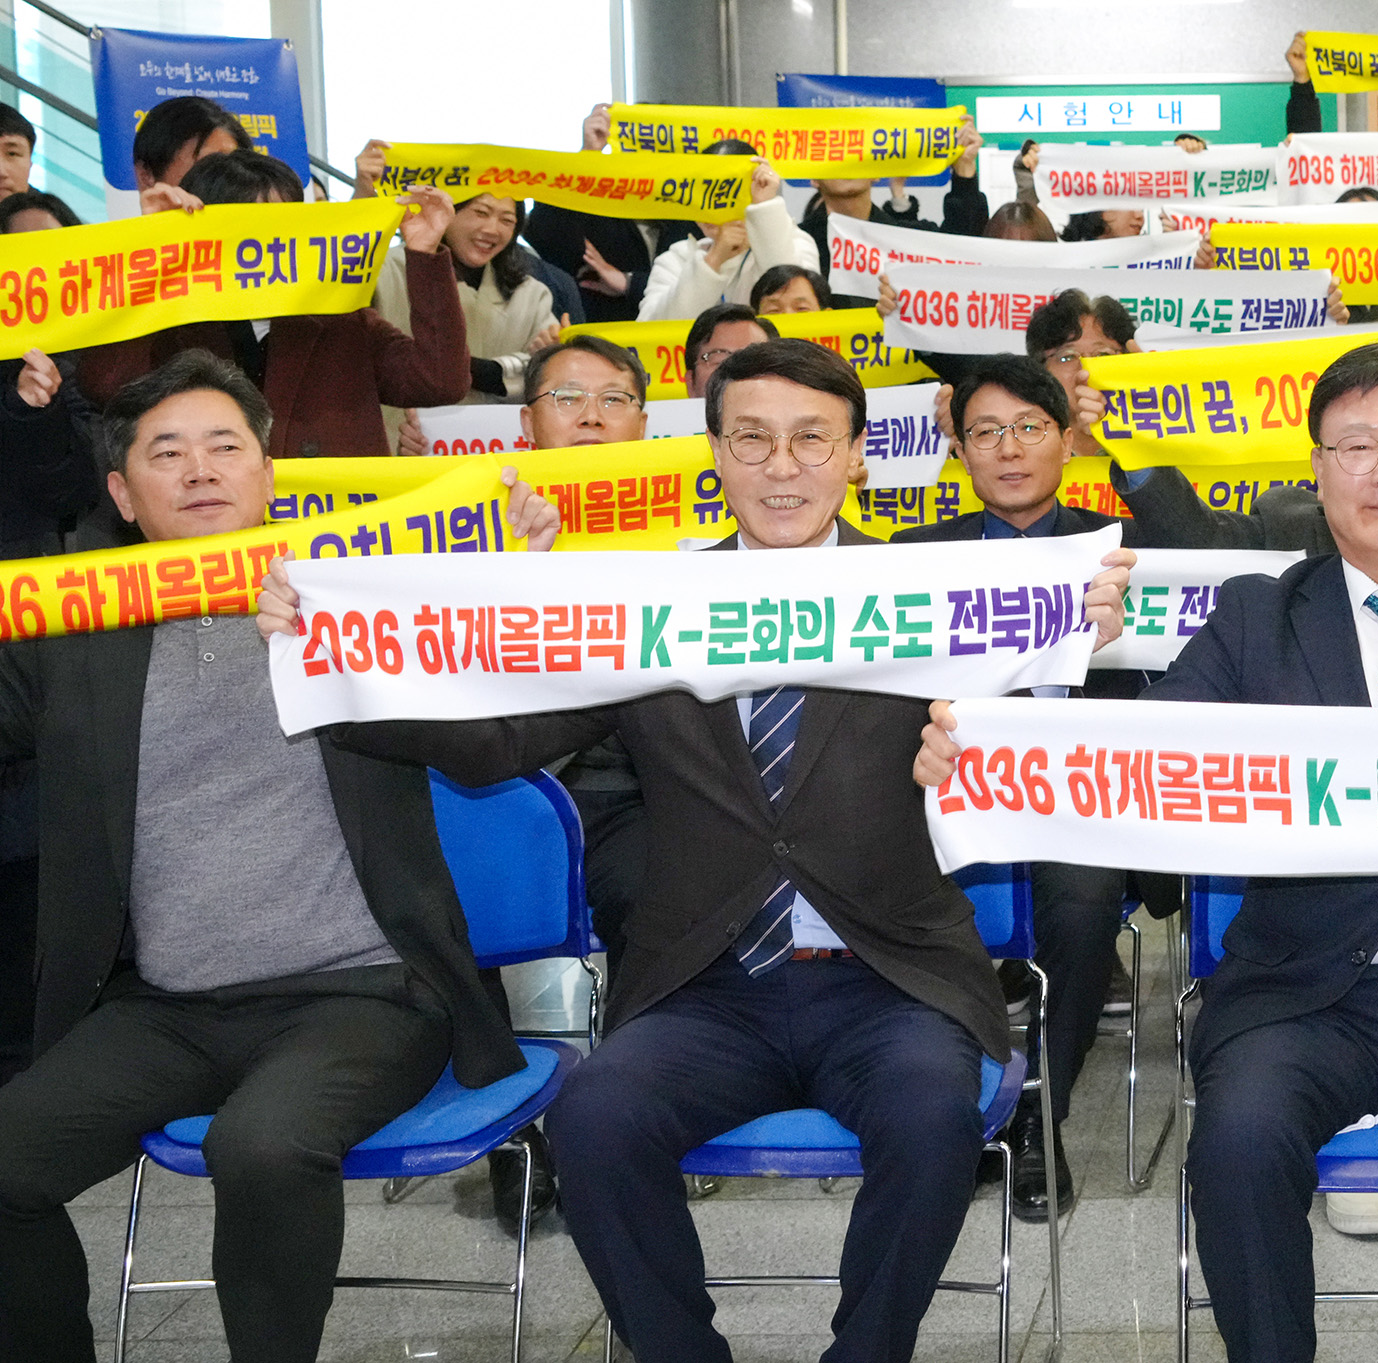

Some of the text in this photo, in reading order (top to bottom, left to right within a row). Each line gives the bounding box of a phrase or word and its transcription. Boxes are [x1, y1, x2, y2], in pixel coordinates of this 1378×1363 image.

[1313, 48, 1363, 74] 전북의
[620, 123, 675, 151] 전북의
[683, 127, 697, 151] 꿈
[774, 131, 863, 160] 하계올림픽
[873, 130, 907, 160] 유치
[918, 128, 957, 157] 기원!
[478, 168, 546, 185] 2036
[551, 175, 653, 199] 하계올림픽
[656, 180, 695, 207] 유치
[701, 181, 743, 207] 기원!
[1050, 169, 1269, 197] 2036 하계올림픽 K-문화의
[1289, 156, 1334, 185] 2036
[833, 237, 880, 275] 2036
[1291, 249, 1309, 270] 꿈
[1, 232, 381, 326] 36 하계올림픽 유치 기원!
[898, 289, 958, 327] 2036
[968, 291, 1054, 330] 하계올
[1190, 299, 1233, 333] 수도
[1240, 298, 1327, 331] 전북에서
[657, 346, 686, 383] 20
[851, 333, 890, 372] 유치
[1102, 385, 1194, 438] 전북의
[1203, 382, 1248, 433] 꿈,
[1256, 373, 1319, 428] 20
[864, 416, 941, 459] 북에서
[537, 470, 738, 534] 계올림픽 유
[936, 483, 961, 522] 꿈
[414, 605, 625, 674] 하계올림픽
[640, 597, 835, 668] K-문화의
[850, 593, 932, 661] 수도
[1066, 746, 1291, 825] 하계올림픽
